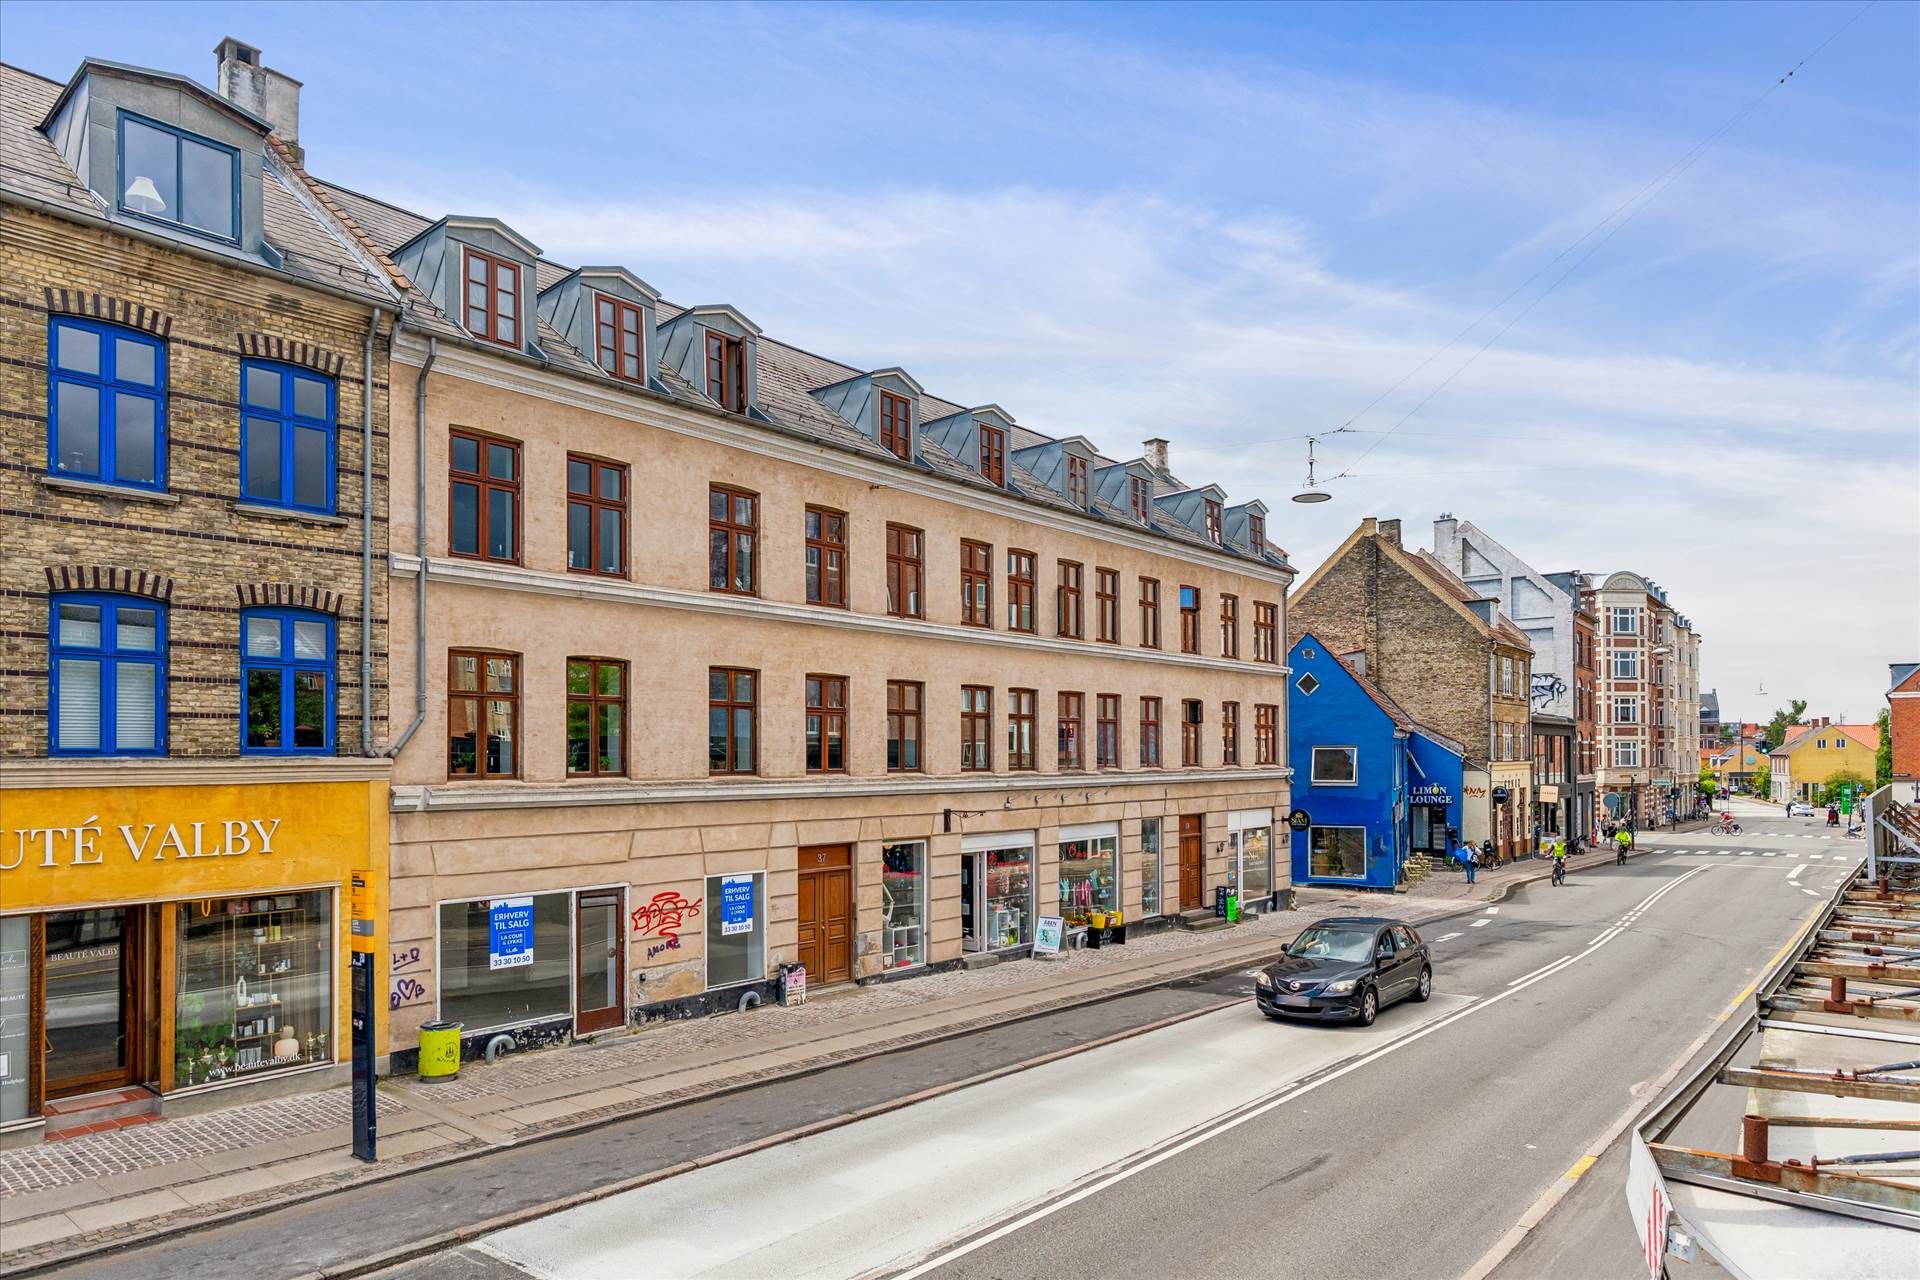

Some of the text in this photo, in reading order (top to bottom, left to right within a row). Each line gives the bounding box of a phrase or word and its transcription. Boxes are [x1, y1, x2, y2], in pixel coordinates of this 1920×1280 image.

[1410, 795, 1453, 804] LOUNGE
[0, 815, 281, 870] UTÉ VALBY
[725, 886, 750, 895] ERHVERV
[725, 893, 750, 903] TIL SALG
[494, 910, 529, 921] ERHVERV
[494, 919, 529, 931] TIL SALG
[90, 946, 119, 958] VALBY
[493, 955, 530, 967] 33 30 10 50
[208, 1051, 301, 1077] www.beautevalby.dk
